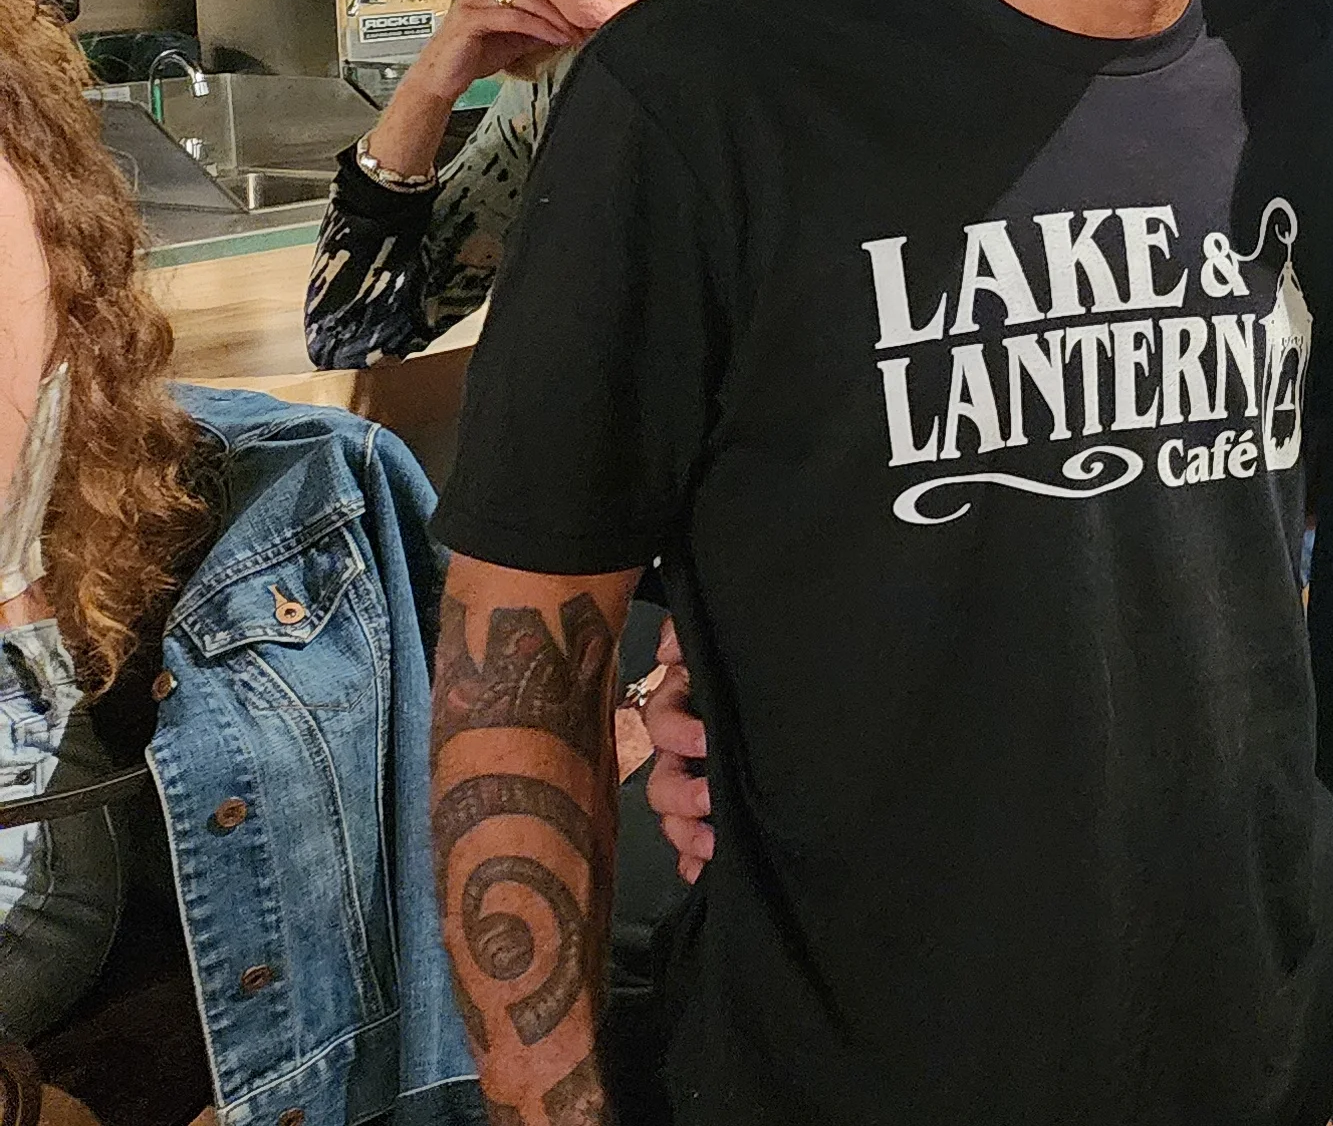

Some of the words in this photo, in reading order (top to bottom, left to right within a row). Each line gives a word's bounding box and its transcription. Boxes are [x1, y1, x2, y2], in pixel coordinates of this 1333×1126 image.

[365, 14, 432, 32] ROCKET
[861, 205, 1189, 350] LAKE
[1200, 232, 1250, 298] &
[876, 313, 1259, 468] LANTERN
[1157, 430, 1258, 487] Café
